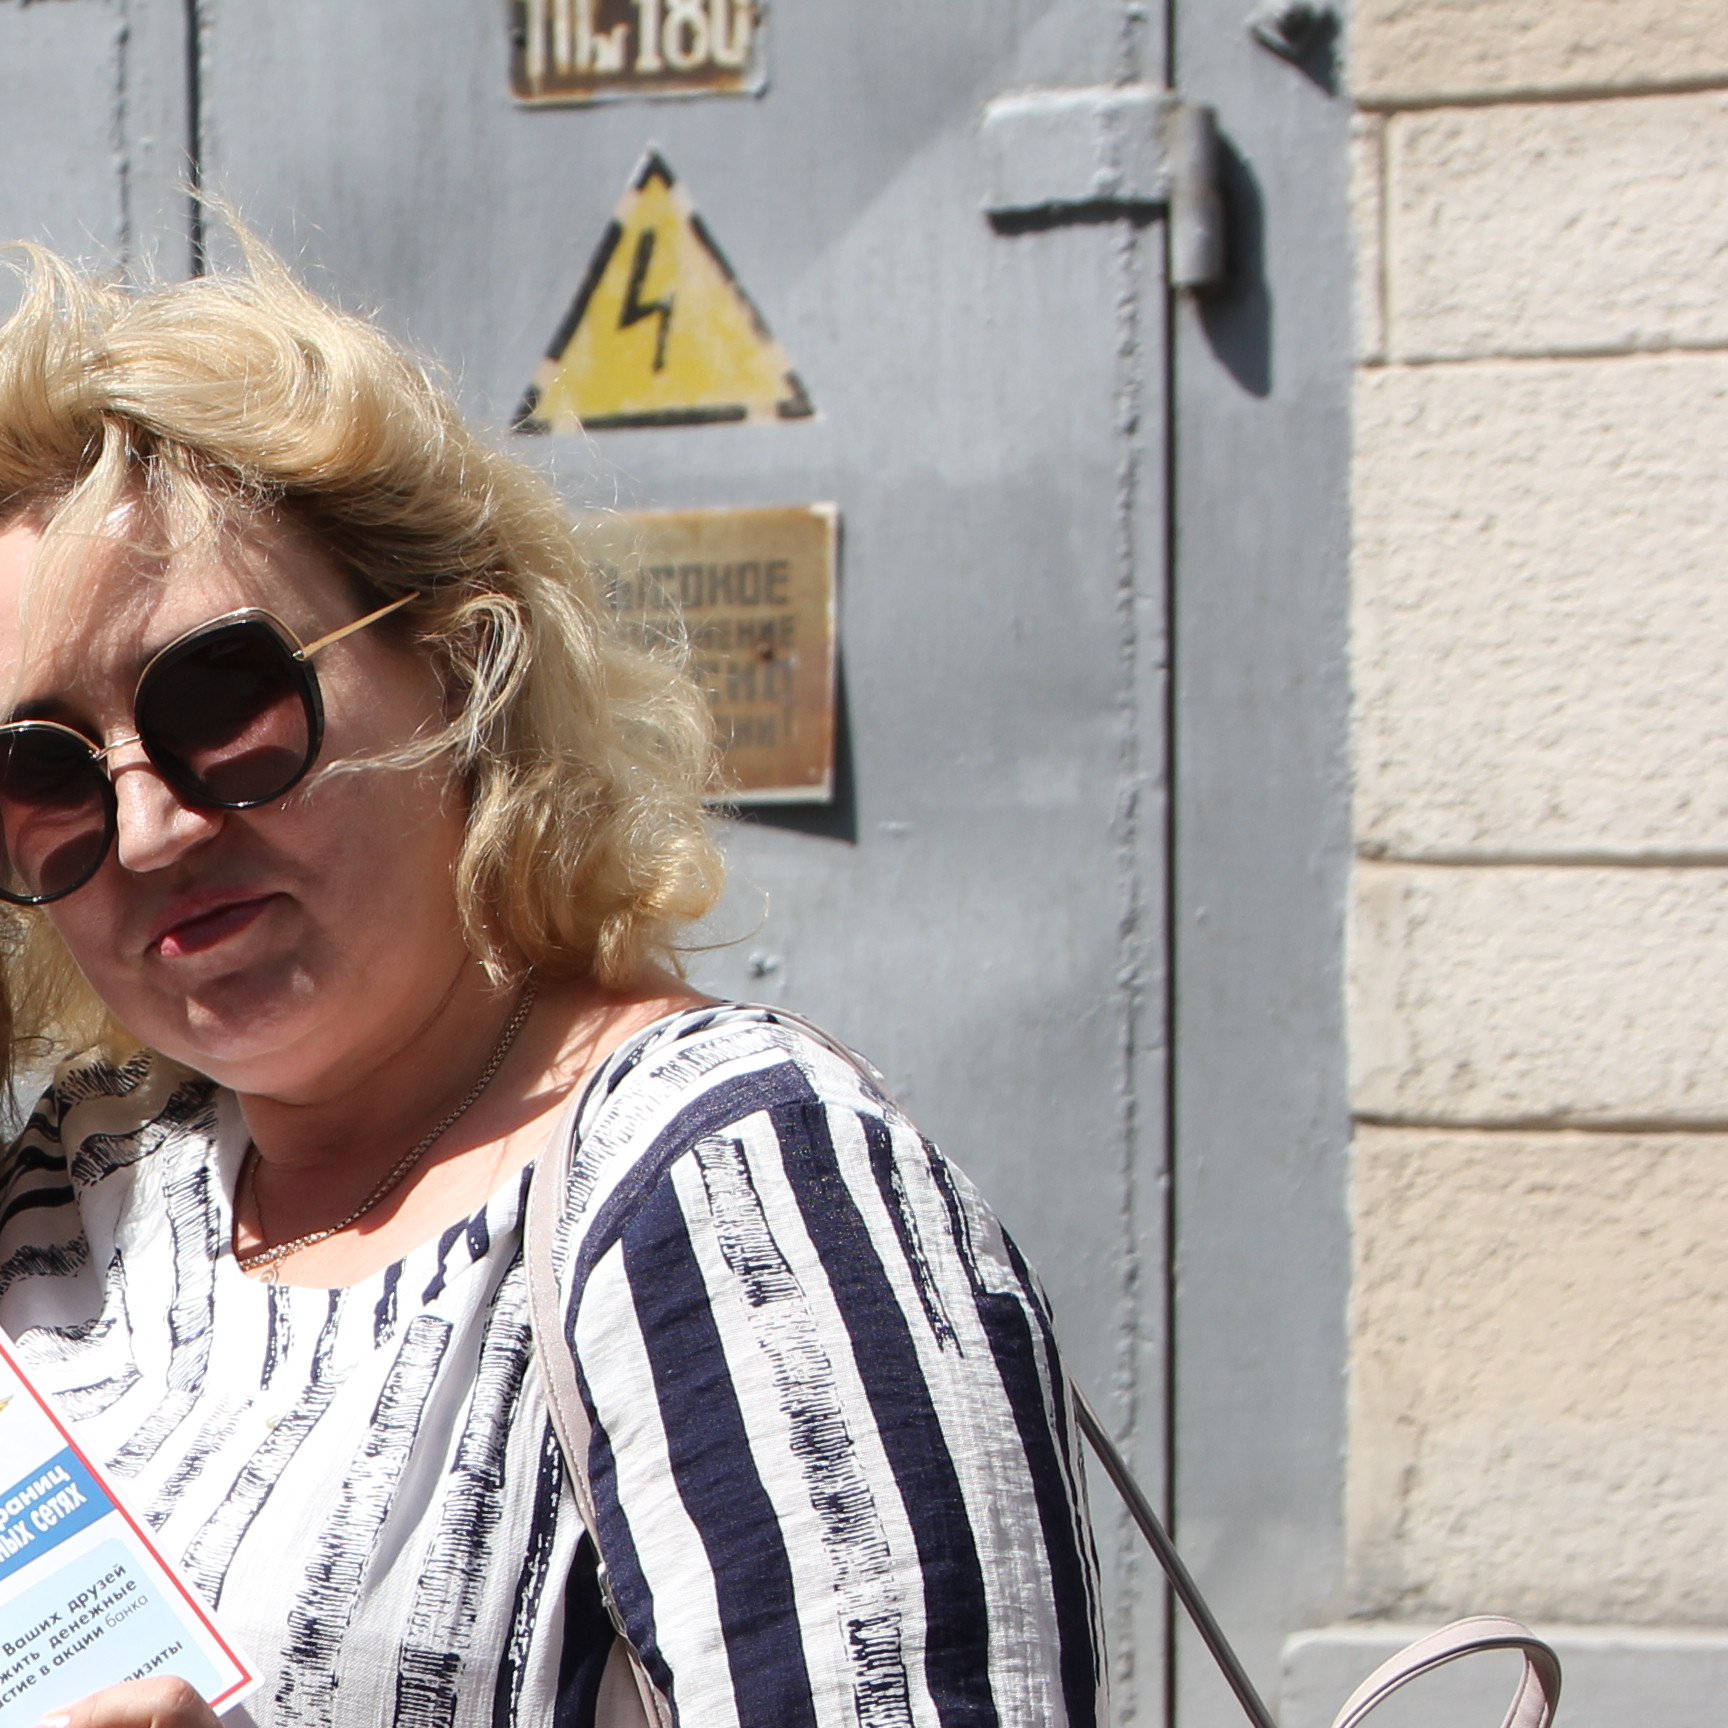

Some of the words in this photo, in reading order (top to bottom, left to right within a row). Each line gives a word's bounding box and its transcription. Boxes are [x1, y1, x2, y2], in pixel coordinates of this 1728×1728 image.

[30, 1482, 87, 1532] сетях
[1, 1612, 63, 1657] Ваших
[67, 1563, 127, 1614] друзей
[39, 1665, 51, 1676] в
[52, 1625, 105, 1667] акции
[104, 1594, 149, 1628] банка
[48, 1580, 137, 1650] денежные
[124, 1641, 184, 1682] изиты
